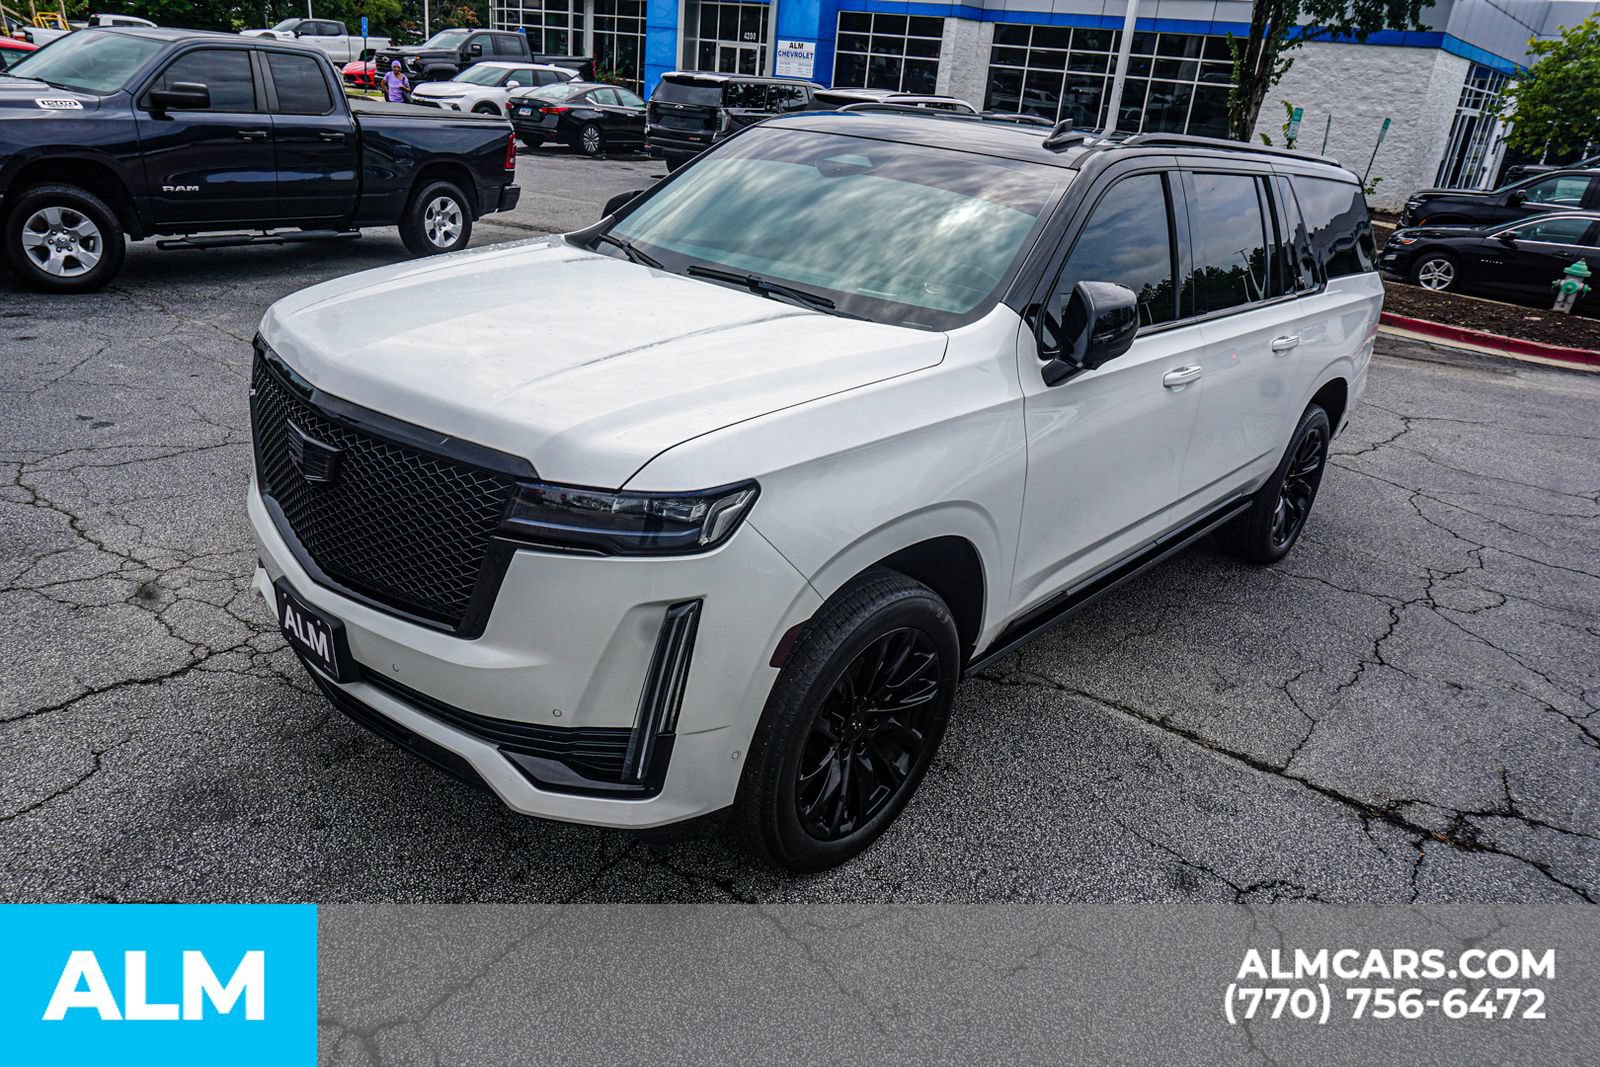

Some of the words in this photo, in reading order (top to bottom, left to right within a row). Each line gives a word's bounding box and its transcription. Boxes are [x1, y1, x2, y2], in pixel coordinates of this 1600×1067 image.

[743, 31, 757, 40] 4200
[788, 42, 804, 50] ALM
[777, 50, 814, 60] CHEVROLET
[284, 604, 330, 663] ALM
